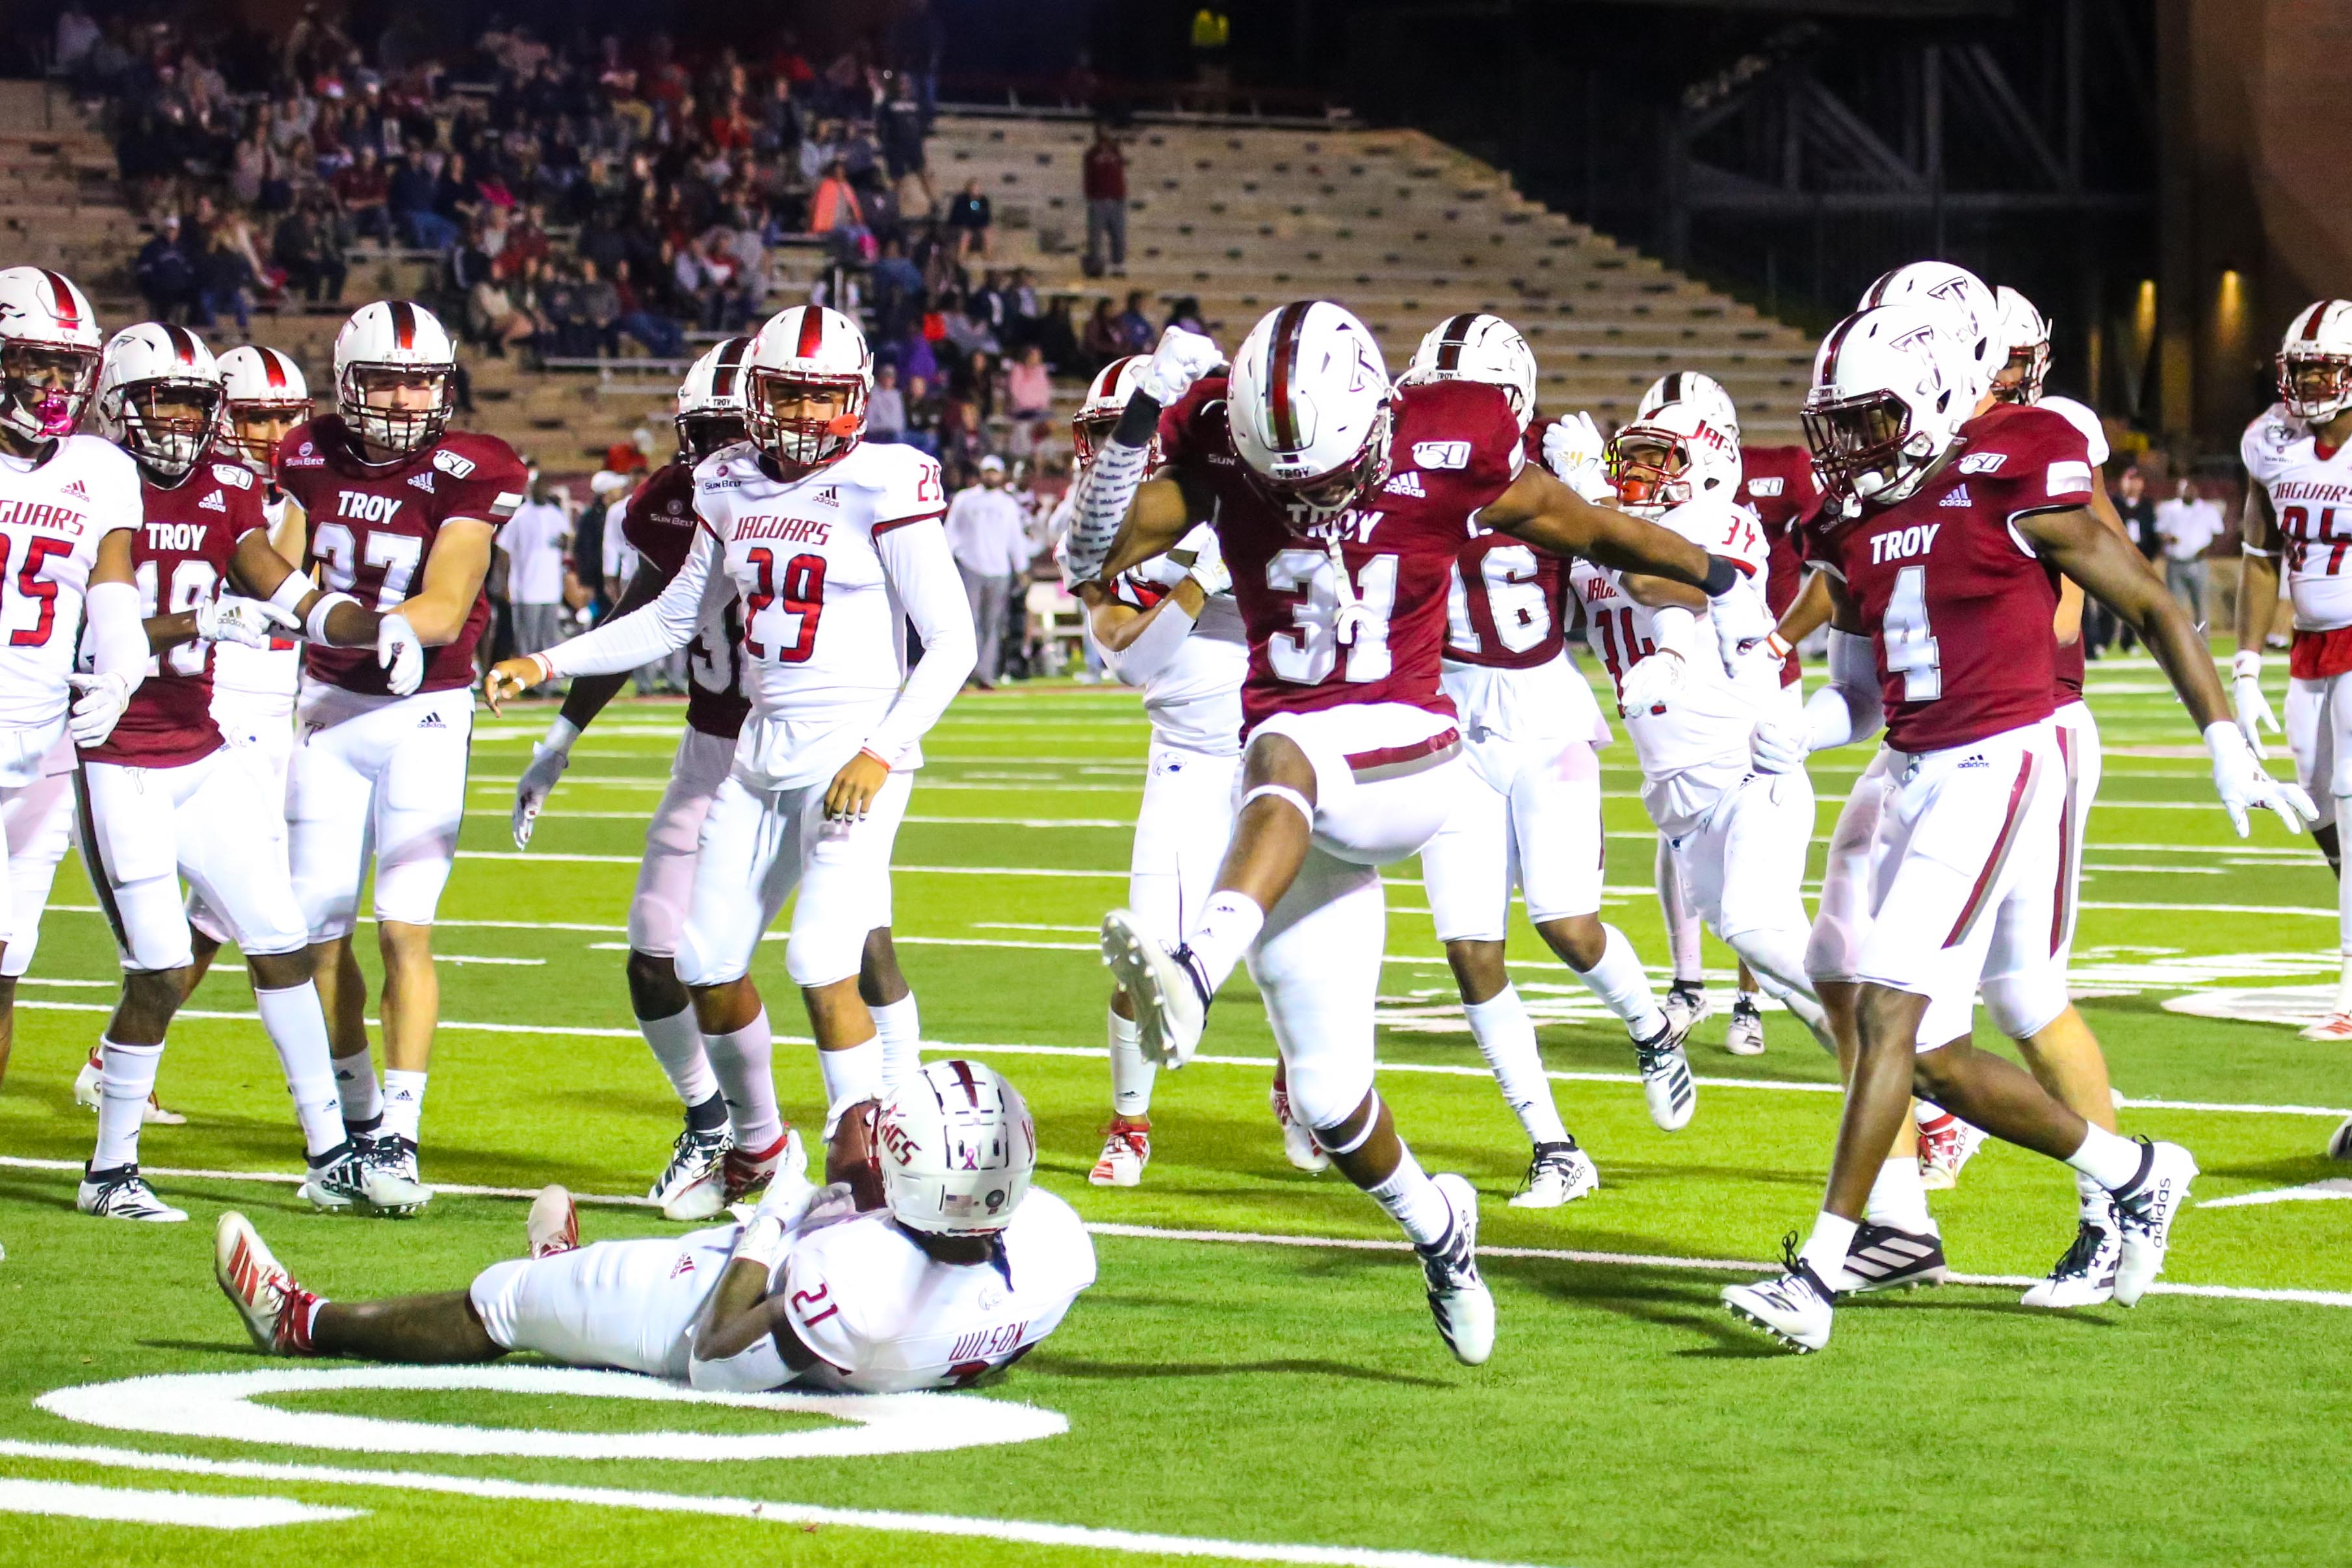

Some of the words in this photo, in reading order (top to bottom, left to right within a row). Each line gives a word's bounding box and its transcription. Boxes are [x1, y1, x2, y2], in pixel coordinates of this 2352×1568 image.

[304, 457, 325, 465] BELT
[433, 449, 476, 480] 150
[1208, 454, 1235, 466] SUN
[1411, 441, 1471, 469] 150
[1958, 452, 2008, 475] 150
[212, 464, 254, 491] 150
[408, 478, 435, 494] adidas
[917, 464, 941, 502] 29
[1276, 467, 1309, 478] TROY
[60, 488, 90, 503] adidas
[198, 501, 226, 513] adidas
[337, 491, 402, 525] TROY
[813, 496, 839, 508] adidas
[1939, 499, 1972, 508] adidas
[650, 514, 670, 523] SUN
[672, 517, 694, 527] BELT
[731, 516, 832, 545] JAGUARS
[1721, 515, 1756, 553] 34
[146, 523, 207, 551] TROY
[1870, 523, 1941, 565] TROY
[312, 521, 423, 613] 37
[0, 532, 75, 647] 5
[1447, 545, 1552, 654] 16
[746, 547, 827, 664] 29
[1266, 549, 1399, 686] 31
[218, 617, 246, 629] adidas
[1883, 565, 1941, 701] 4
[1957, 760, 1990, 768] adidas
[2152, 1177, 2171, 1248] adidas
[670, 1251, 689, 1280] adidas
[791, 1283, 838, 1329] 21
[948, 1320, 1029, 1362] WILSON
